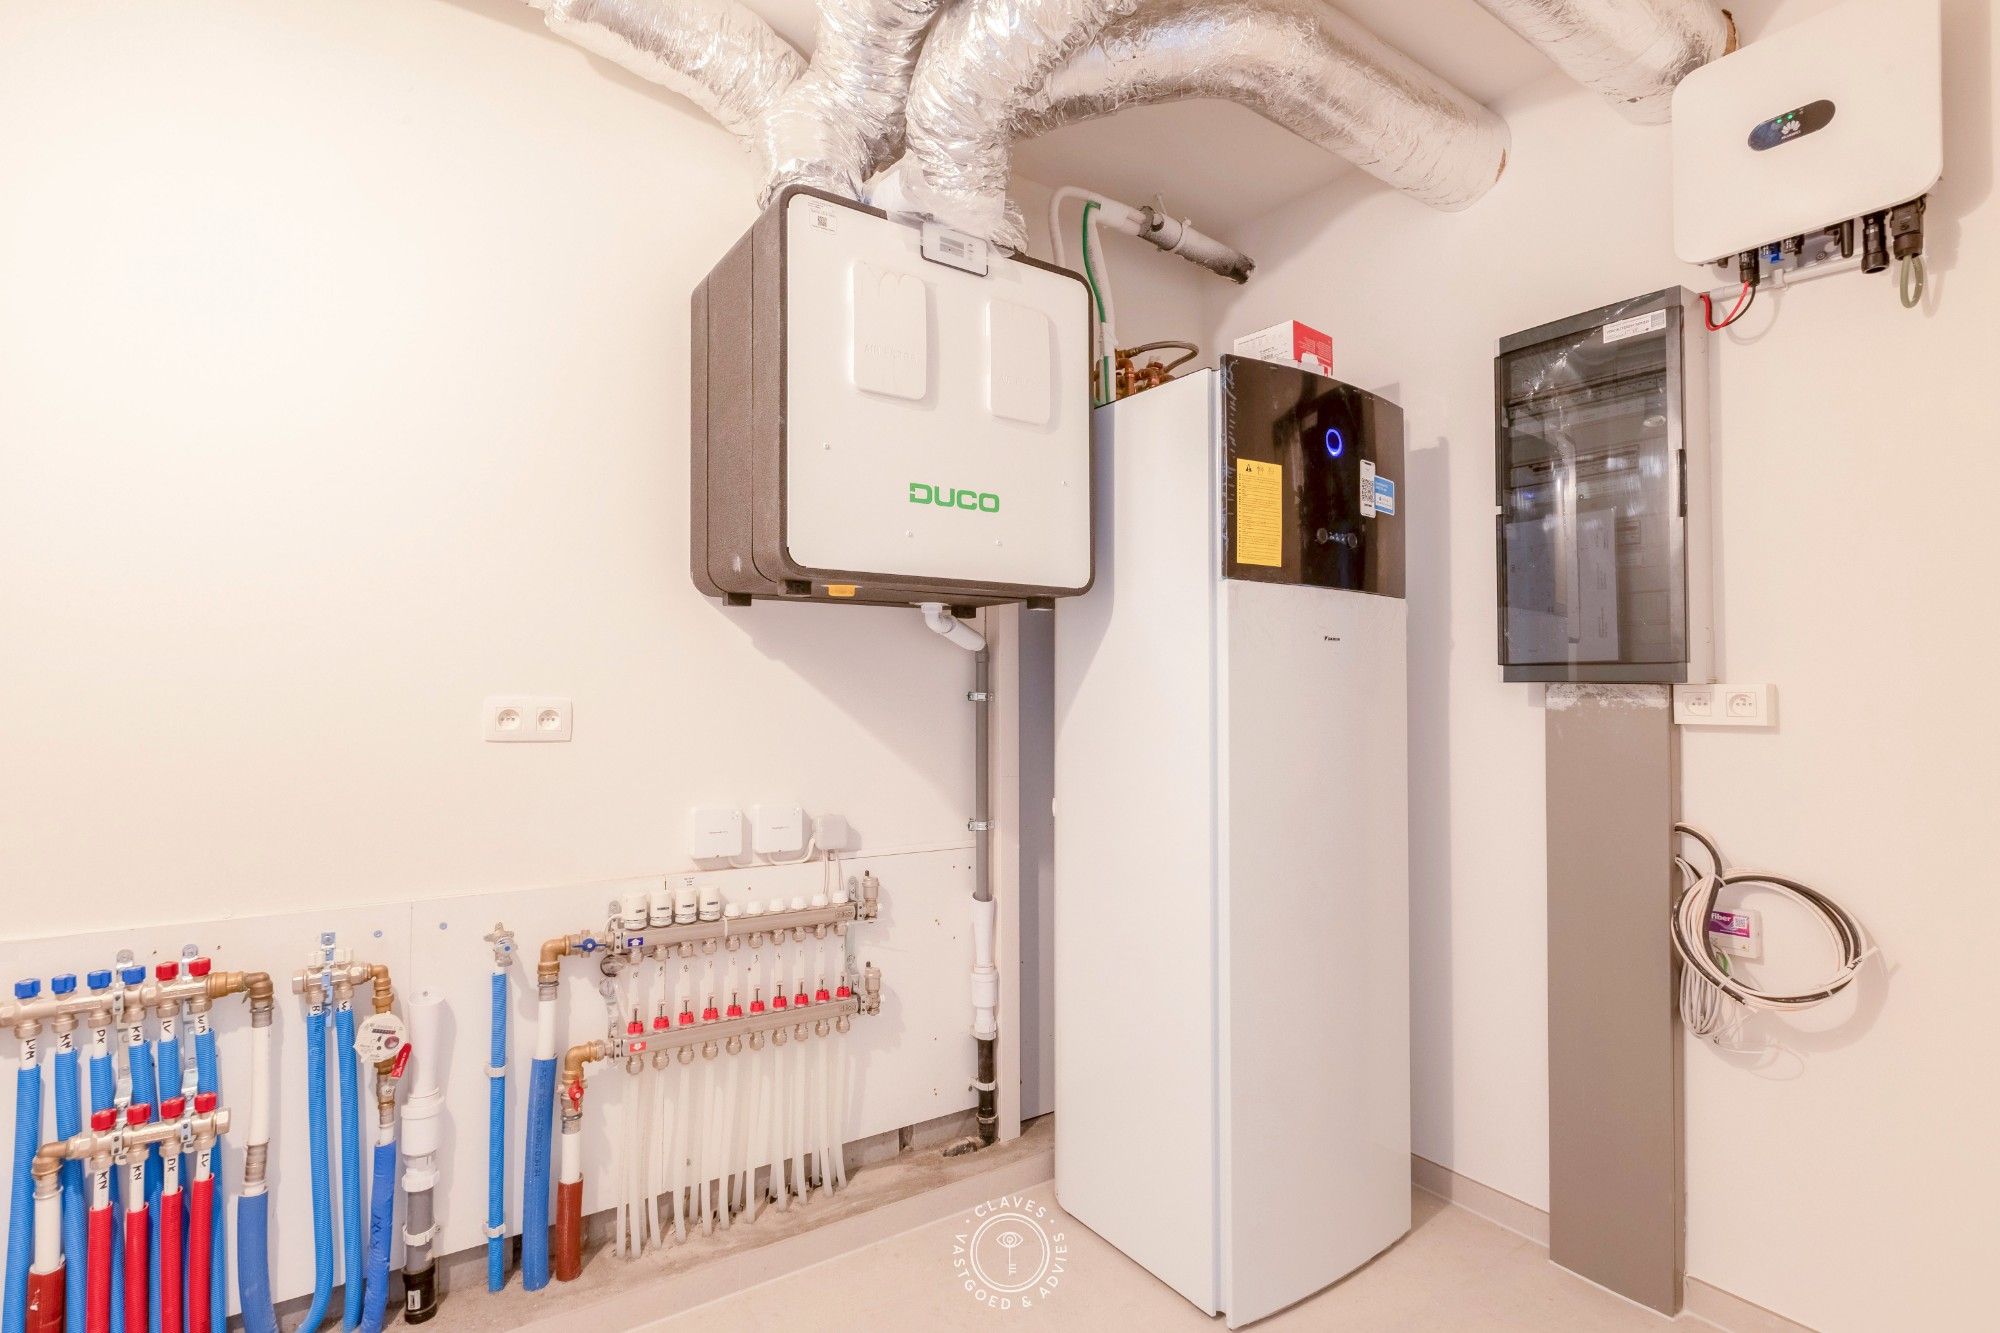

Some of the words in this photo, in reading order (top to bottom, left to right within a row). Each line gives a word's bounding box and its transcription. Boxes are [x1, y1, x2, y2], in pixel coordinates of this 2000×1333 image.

[909, 482, 1000, 513] DUCO
[131, 1025, 142, 1041] KN
[98, 1170, 109, 1189] KN
[133, 1164, 142, 1180] KN
